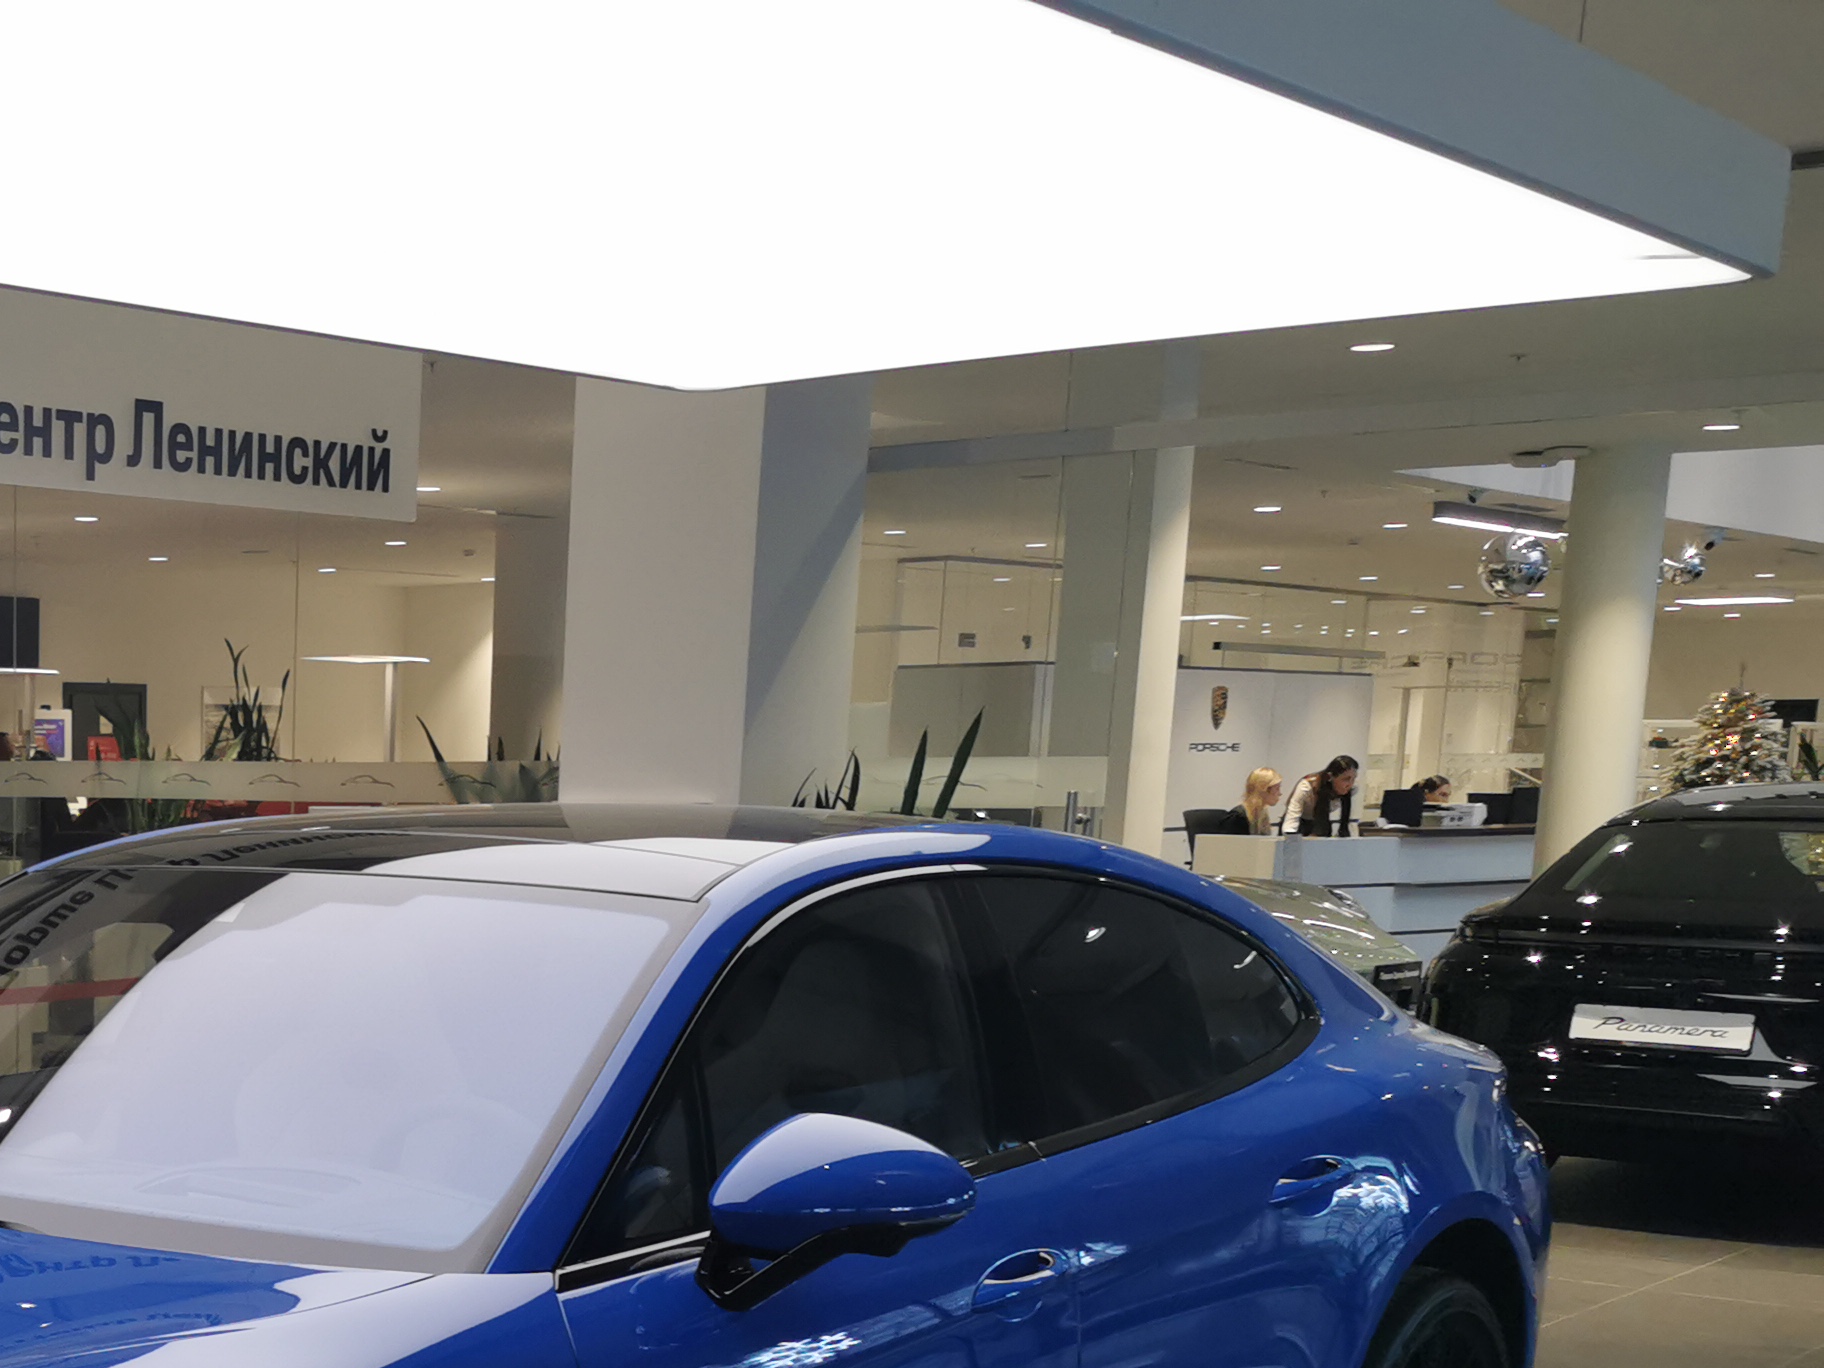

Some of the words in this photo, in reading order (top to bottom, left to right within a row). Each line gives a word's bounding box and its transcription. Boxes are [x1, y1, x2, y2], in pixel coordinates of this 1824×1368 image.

[126, 398, 391, 493] Ленинский
[1189, 742, 1240, 753] PORSCHE
[1593, 1016, 1728, 1038] Panamera
